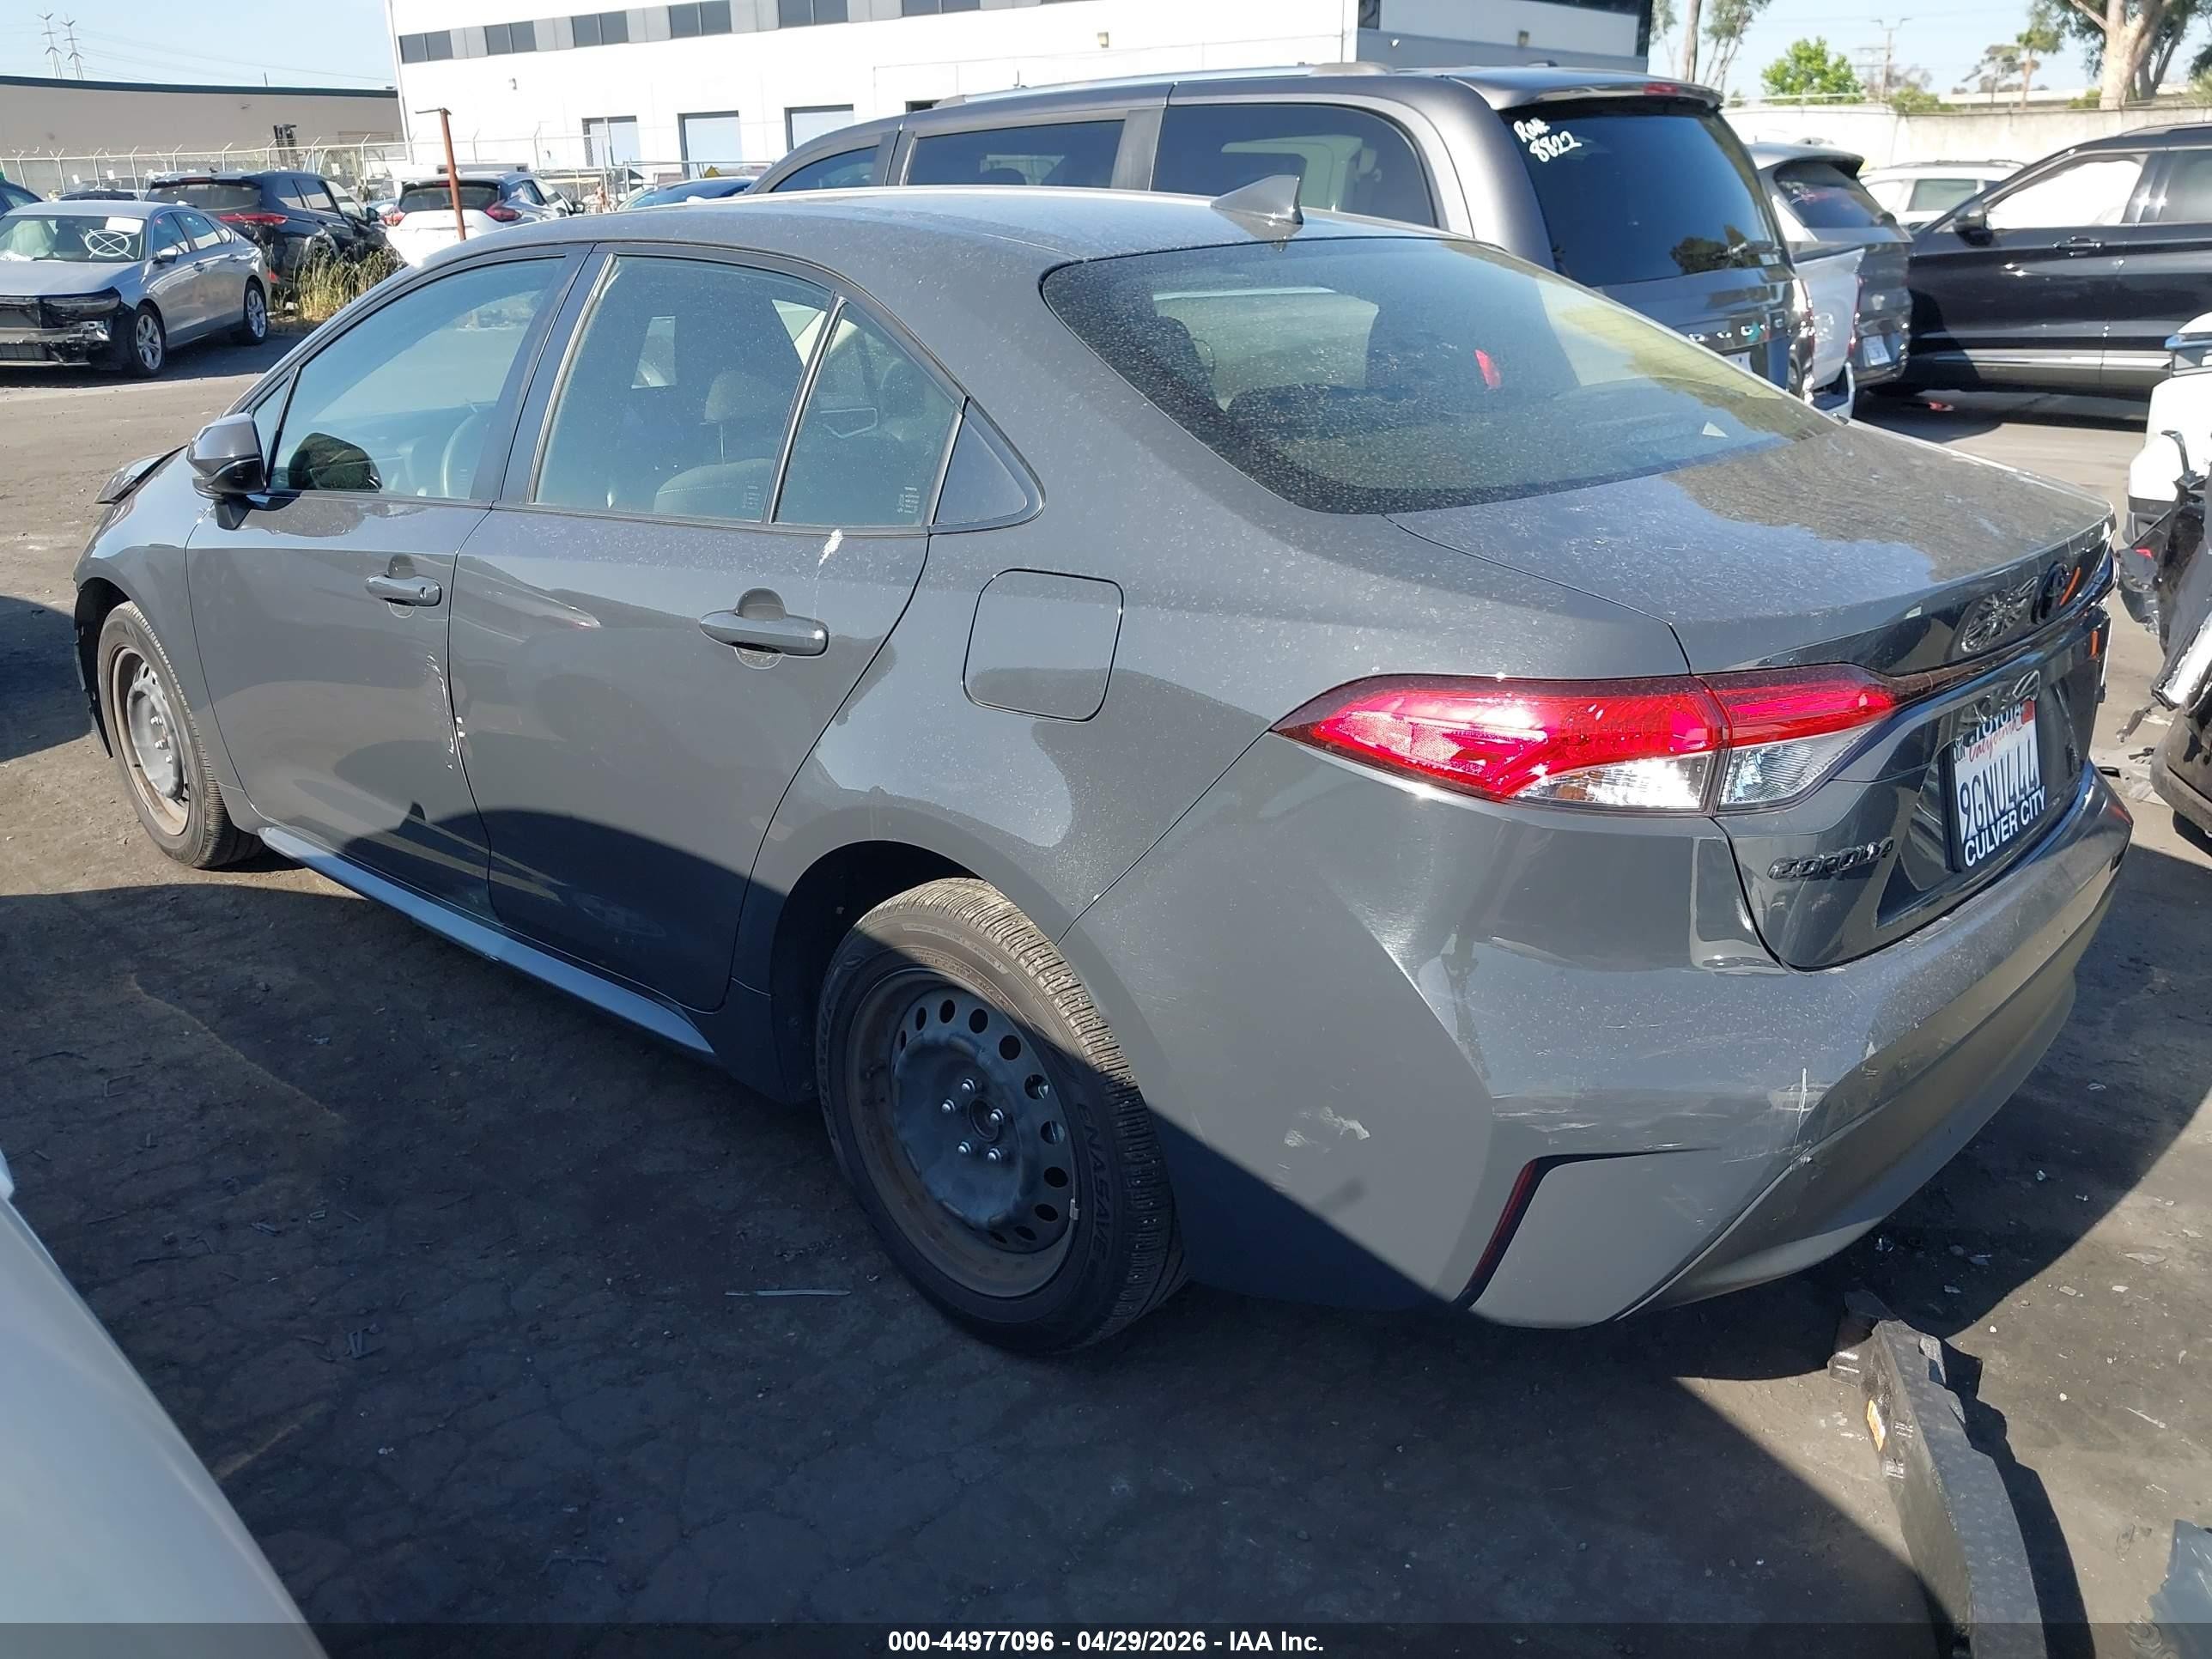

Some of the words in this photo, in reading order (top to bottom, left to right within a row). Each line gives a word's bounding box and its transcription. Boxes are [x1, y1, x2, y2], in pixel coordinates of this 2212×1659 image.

[1529, 131, 1583, 162] 8822
[1960, 738, 2038, 840] 9GNU444
[1964, 812, 2018, 867] CULVER
[2021, 786, 2046, 826] CITY
[1077, 1103, 1110, 1261] ENASAVE
